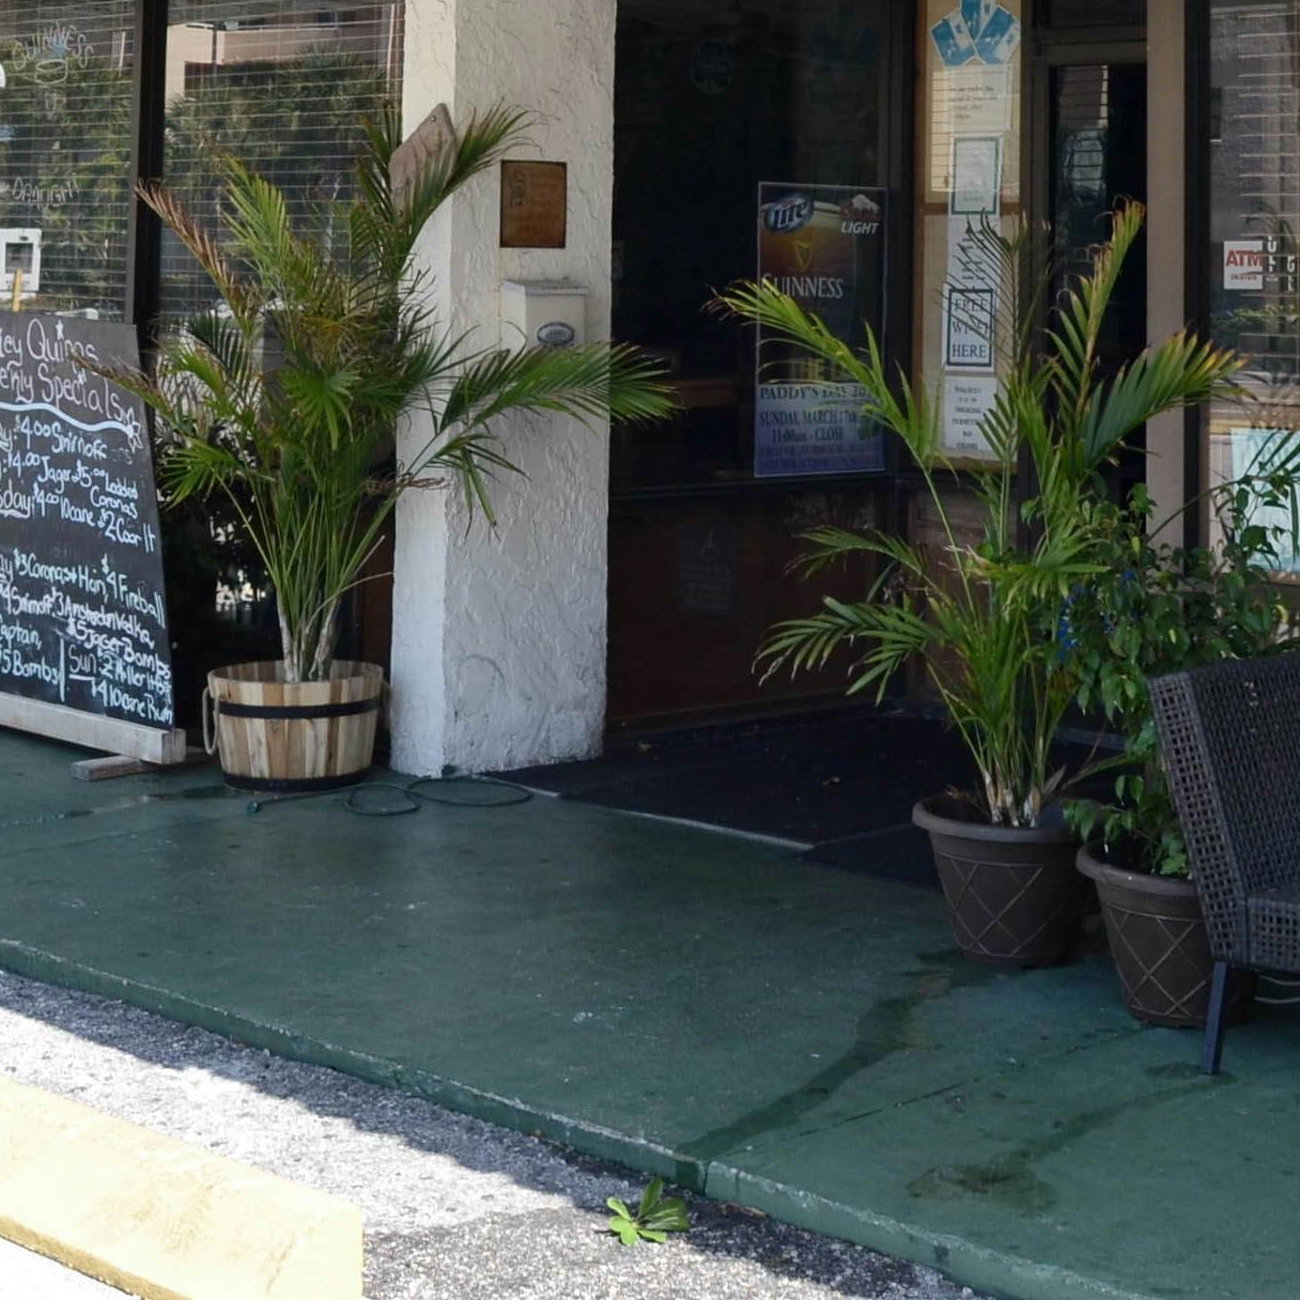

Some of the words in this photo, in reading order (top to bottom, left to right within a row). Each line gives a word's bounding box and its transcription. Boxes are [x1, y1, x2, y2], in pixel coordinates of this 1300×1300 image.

[841, 221, 879, 235] LIGHT
[1226, 250, 1267, 267] ATM
[952, 343, 987, 359] HERE
[760, 386, 818, 400] PADDY'S
